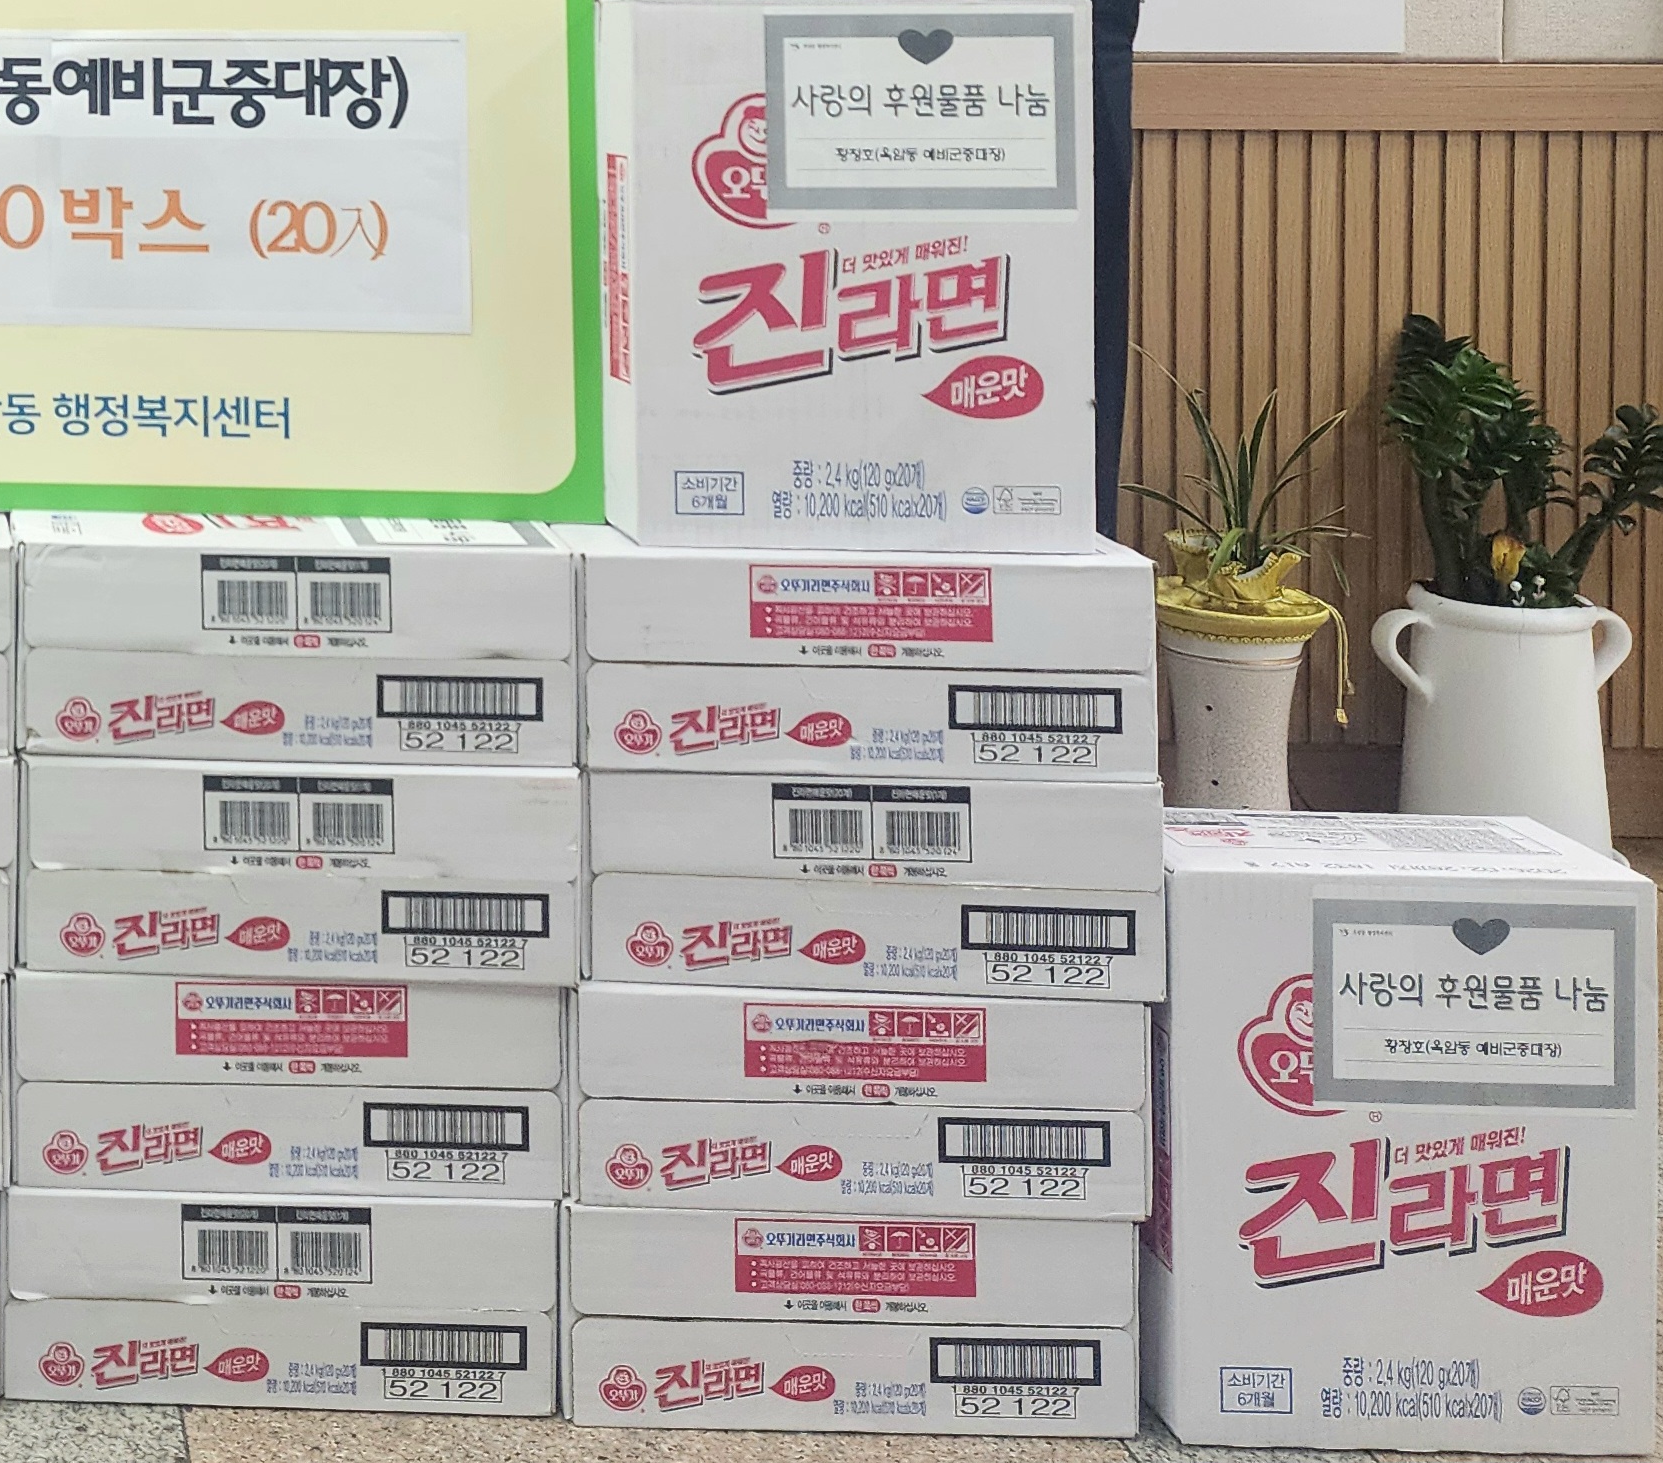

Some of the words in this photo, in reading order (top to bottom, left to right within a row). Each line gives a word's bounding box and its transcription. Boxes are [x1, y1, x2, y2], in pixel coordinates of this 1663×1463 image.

[791, 84, 872, 117] 사랑의
[882, 85, 987, 118] 후원물품
[997, 84, 1050, 116] 나눔
[842, 255, 856, 274] 더
[862, 246, 910, 271] 맛있게
[914, 235, 968, 263] 매워진!
[691, 247, 1010, 395] 진라면
[950, 367, 1028, 408] 매운맛
[53, 392, 291, 442] 행정복지센터
[681, 476, 738, 492] 소비기간
[792, 460, 814, 486] 중량
[691, 494, 728, 510] 6개월
[803, 494, 840, 520] 10,200
[108, 691, 214, 745] 진라면
[669, 703, 780, 756] 진라면
[800, 717, 844, 742] 매운맛
[404, 731, 444, 751] 52
[459, 731, 513, 751] 122
[978, 743, 1022, 763] 52
[1036, 743, 1092, 764] 122
[112, 909, 220, 961] 진라면
[681, 918, 793, 972] 진라면
[813, 934, 856, 960] 매운맛
[411, 947, 452, 968] 52
[464, 947, 520, 968] 122
[1339, 972, 1425, 1008] 사랑의
[1435, 975, 1543, 1011] 후원물품
[1554, 976, 1609, 1014] 나눔
[96, 1122, 203, 1175] 진라면
[221, 1135, 264, 1159] 매운맛
[1394, 1145, 1409, 1165] 더
[1416, 1136, 1465, 1161] 맛있게
[1471, 1126, 1526, 1153] 매워진!
[659, 1137, 771, 1192] 진라면
[789, 1151, 834, 1176] 매운맛
[1238, 1135, 1569, 1288] 진라면
[1506, 1263, 1588, 1305] 매운맛
[90, 1339, 199, 1390] 진라면
[218, 1352, 261, 1377] 매운맛
[1227, 1371, 1286, 1389] 소비기간
[1342, 1355, 1366, 1387] 중량
[654, 1359, 764, 1412] 진라면
[784, 1372, 828, 1397] 매운맛
[1237, 1390, 1276, 1408] 6개월
[1354, 1390, 1392, 1419] 10,200
